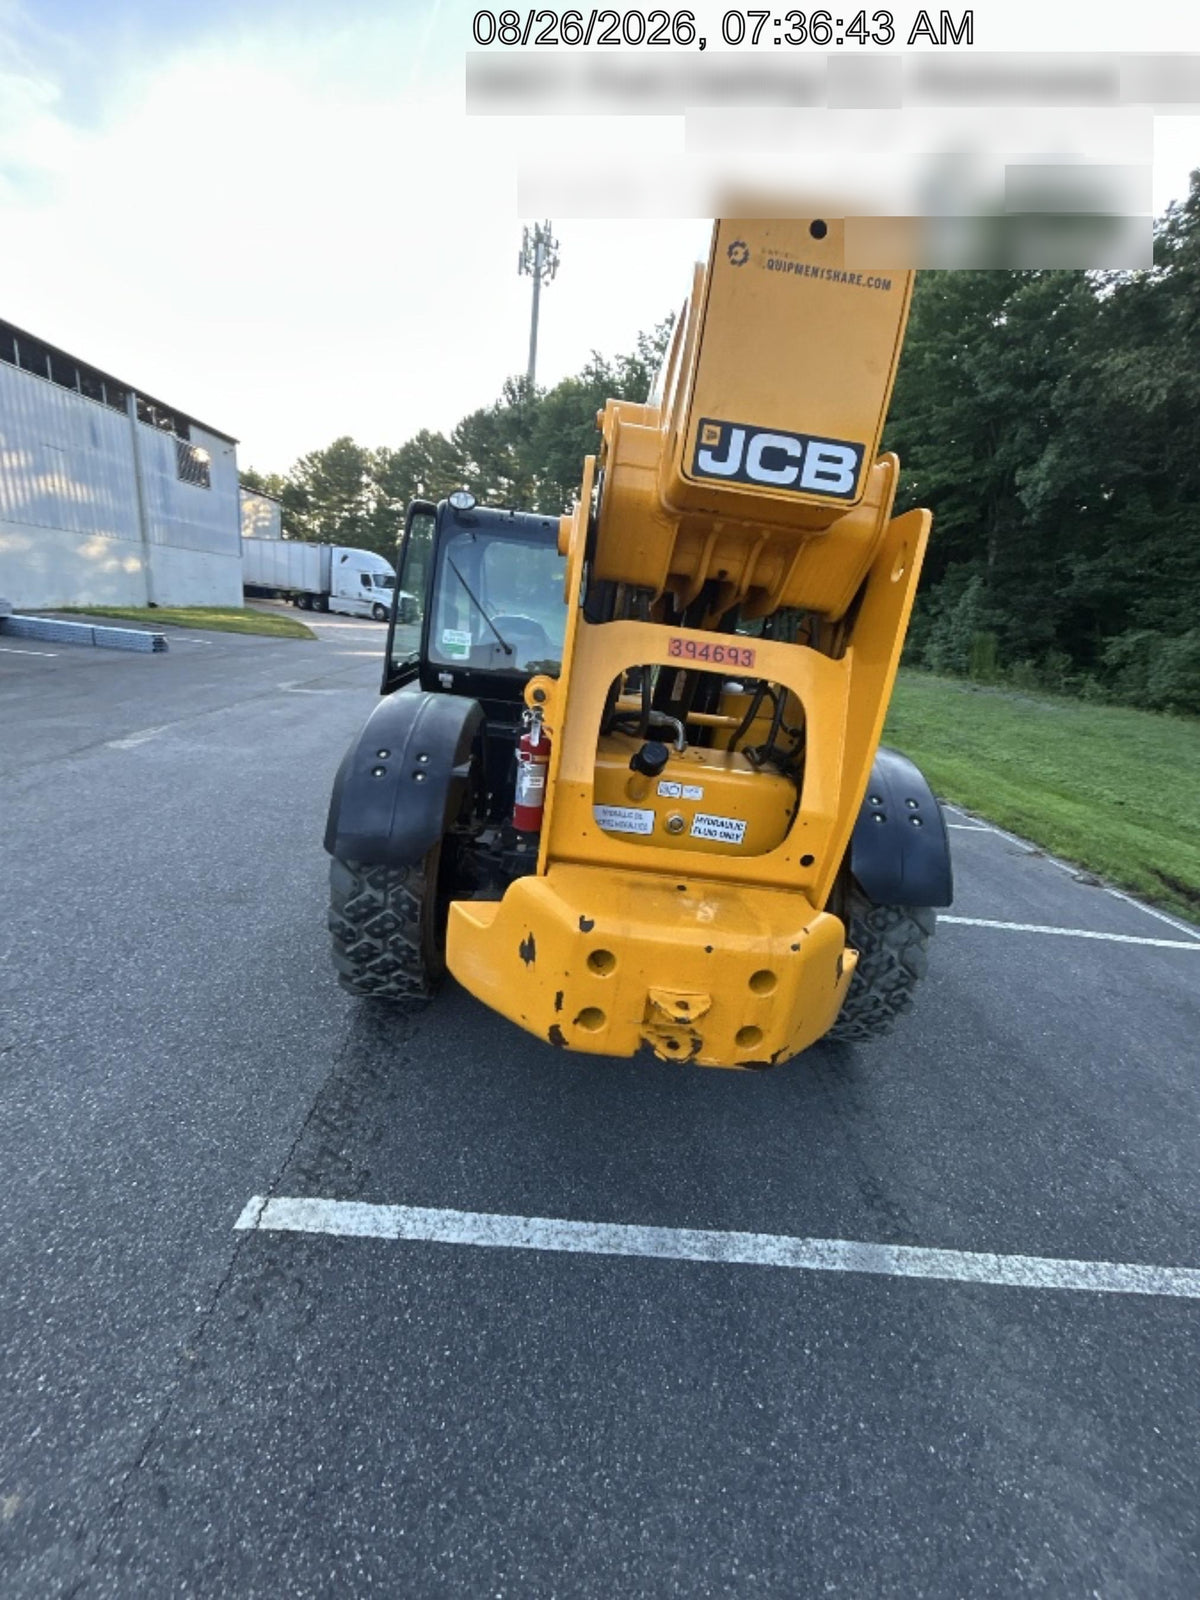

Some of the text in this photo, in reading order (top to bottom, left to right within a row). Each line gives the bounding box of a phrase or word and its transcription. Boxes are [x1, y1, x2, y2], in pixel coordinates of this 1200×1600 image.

[762, 258, 892, 291] QUIPMENTSHARE.COM
[698, 428, 858, 493] JCB
[671, 639, 753, 667] 394693
[693, 826, 742, 841] FLUID ONLY
[695, 815, 744, 831] HYDRAULIC
